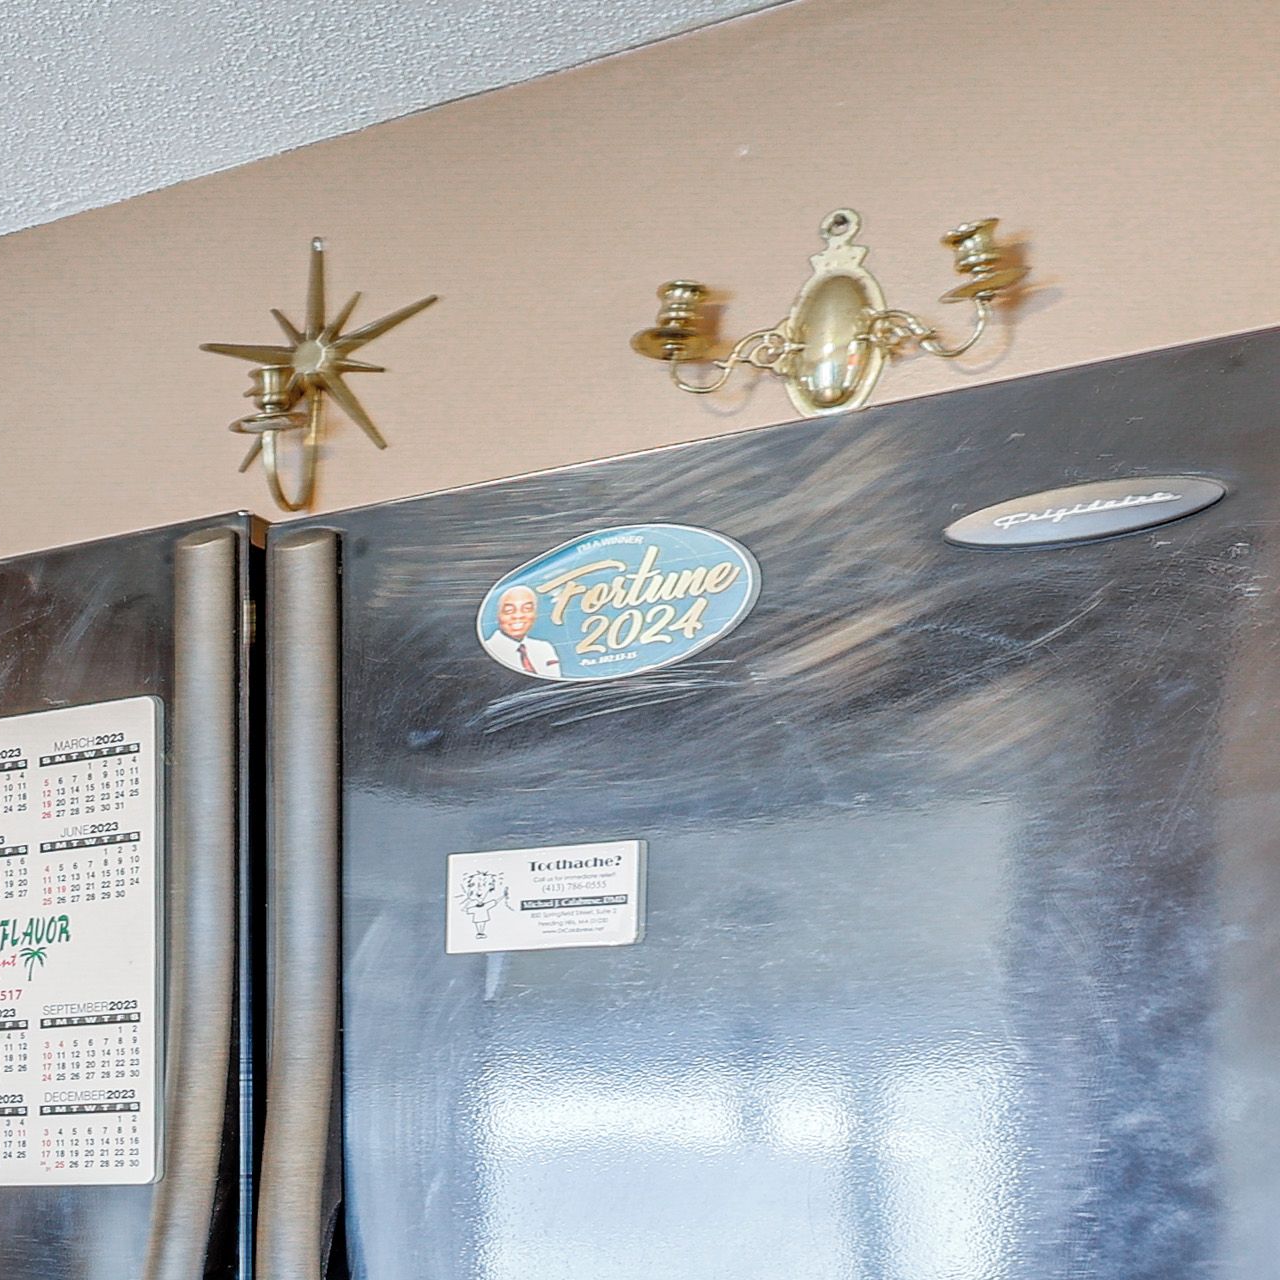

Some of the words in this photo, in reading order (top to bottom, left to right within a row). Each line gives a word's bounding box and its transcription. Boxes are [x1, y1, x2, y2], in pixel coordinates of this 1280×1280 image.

[537, 545, 740, 625] Fortune
[575, 597, 708, 655] 2024
[528, 855, 622, 872] Toothache?
[542, 884, 565, 894] (413)
[0, 914, 71, 952] FLAVOR
